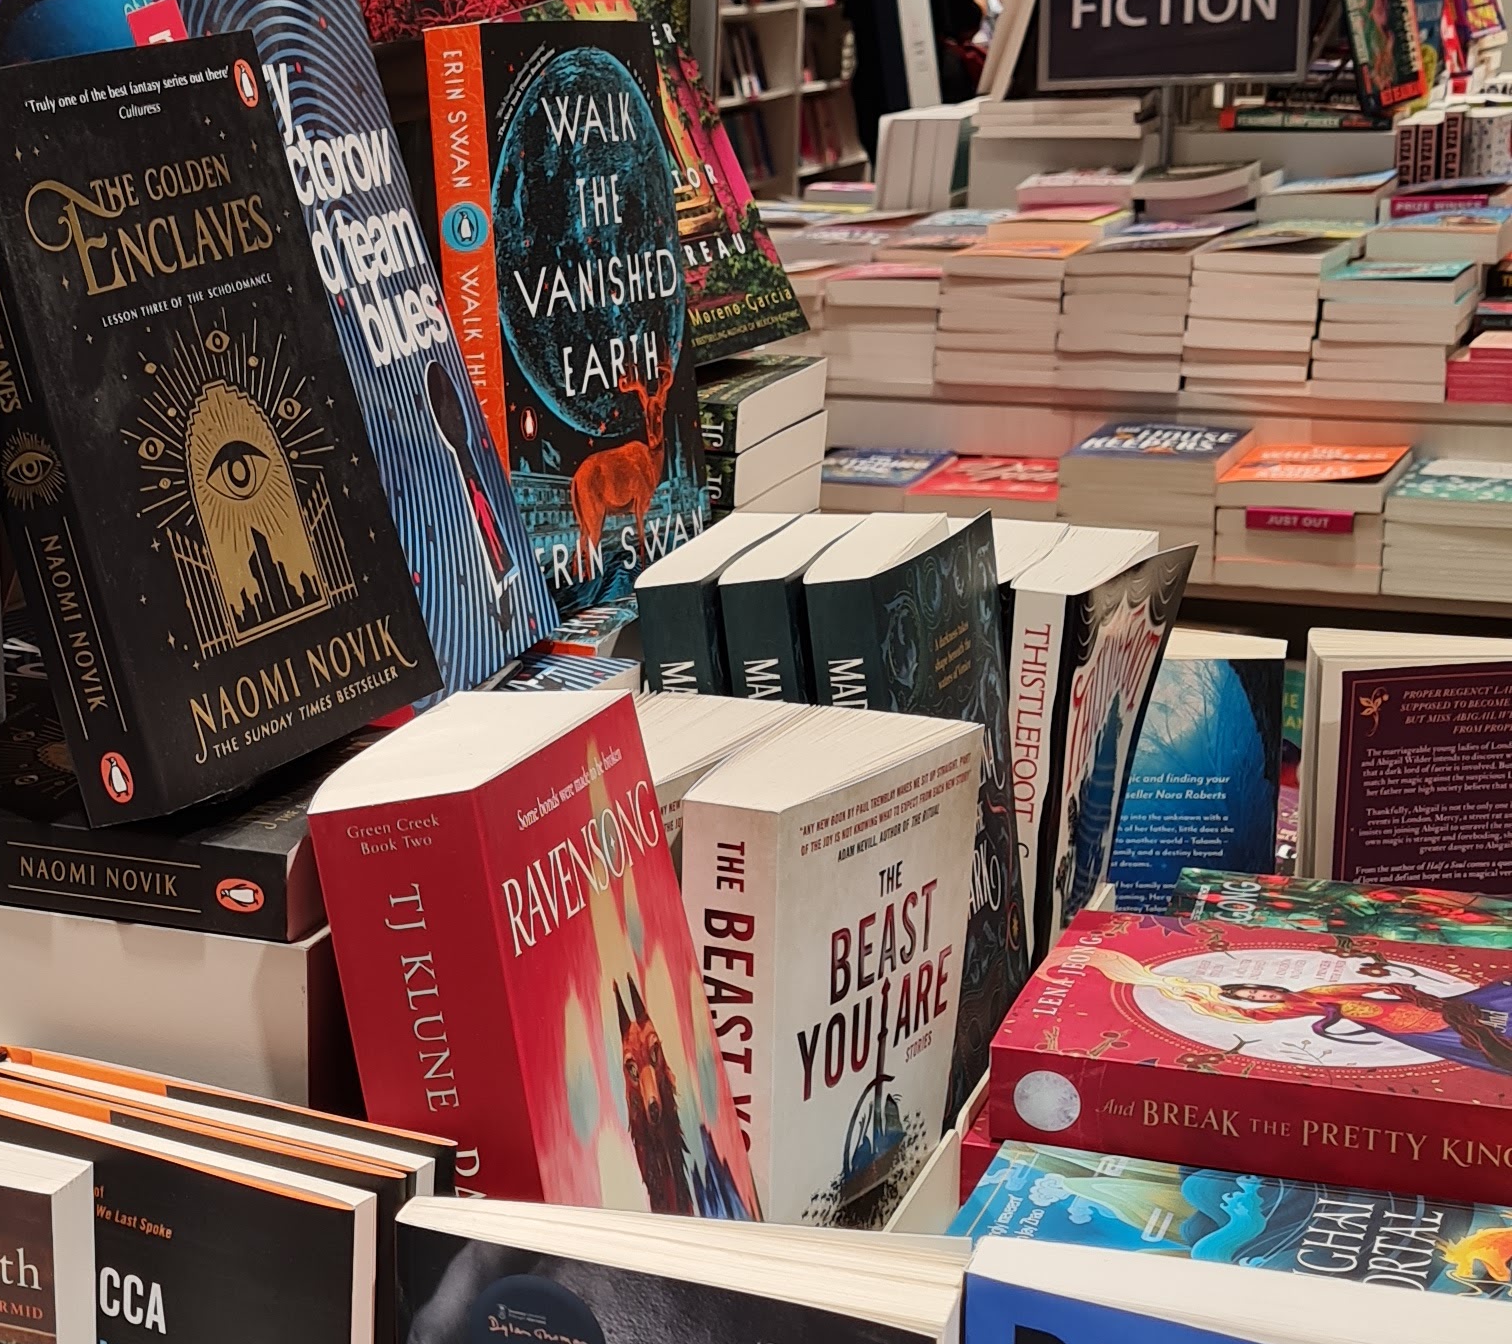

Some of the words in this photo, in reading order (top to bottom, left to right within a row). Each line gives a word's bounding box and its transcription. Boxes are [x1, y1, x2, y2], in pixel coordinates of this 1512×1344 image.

[59, 95, 78, 108] one
[80, 90, 90, 104] of
[91, 87, 107, 102] the
[109, 84, 129, 100] best
[129, 77, 161, 94] fantasy
[163, 73, 189, 89] series
[190, 71, 205, 85] out
[443, 48, 467, 102] ERIN
[445, 110, 473, 191] SWAN
[541, 92, 637, 147] WALK
[90, 173, 140, 211] THE
[144, 154, 231, 201] GOLDEN
[576, 173, 624, 228] THE
[25, 180, 275, 296] ENCLAVES
[344, 207, 426, 284] team
[102, 309, 139, 328] LESSON
[140, 299, 170, 317] THREE
[171, 297, 183, 311] OF
[187, 290, 205, 304] THE
[207, 272, 273, 301] SCHOLOMANCE
[514, 248, 678, 319] VANISHED
[691, 288, 794, 327] Moreno-Garcia
[350, 282, 448, 368] blues
[563, 330, 660, 398] EARTH
[1266, 514, 1299, 526] JUST
[1301, 516, 1330, 529] OUT
[40, 535, 72, 629] NAOMI
[69, 630, 110, 713] NOVIK
[190, 657, 300, 764] NAOMI
[308, 614, 418, 691] NOVIK
[212, 732, 241, 759] THE
[243, 711, 295, 748] SUNDAY
[297, 694, 335, 720] TIMES
[335, 664, 400, 705] BESTSELLER
[1013, 622, 1053, 825] THISTLEFOOT
[347, 816, 393, 841] Green
[398, 813, 440, 835] Creek
[359, 834, 399, 856] Book
[402, 831, 433, 850] Two
[19, 856, 97, 887] NAOMI
[106, 868, 179, 897] NOVIK
[502, 780, 660, 958] RAVENSONG
[716, 841, 745, 893] THE
[878, 860, 903, 898] THE
[383, 883, 427, 933] TJ
[830, 877, 938, 1006] BEAST
[399, 951, 460, 1113] KLUNE
[797, 996, 873, 1102] YOU
[893, 943, 953, 1048] ARE
